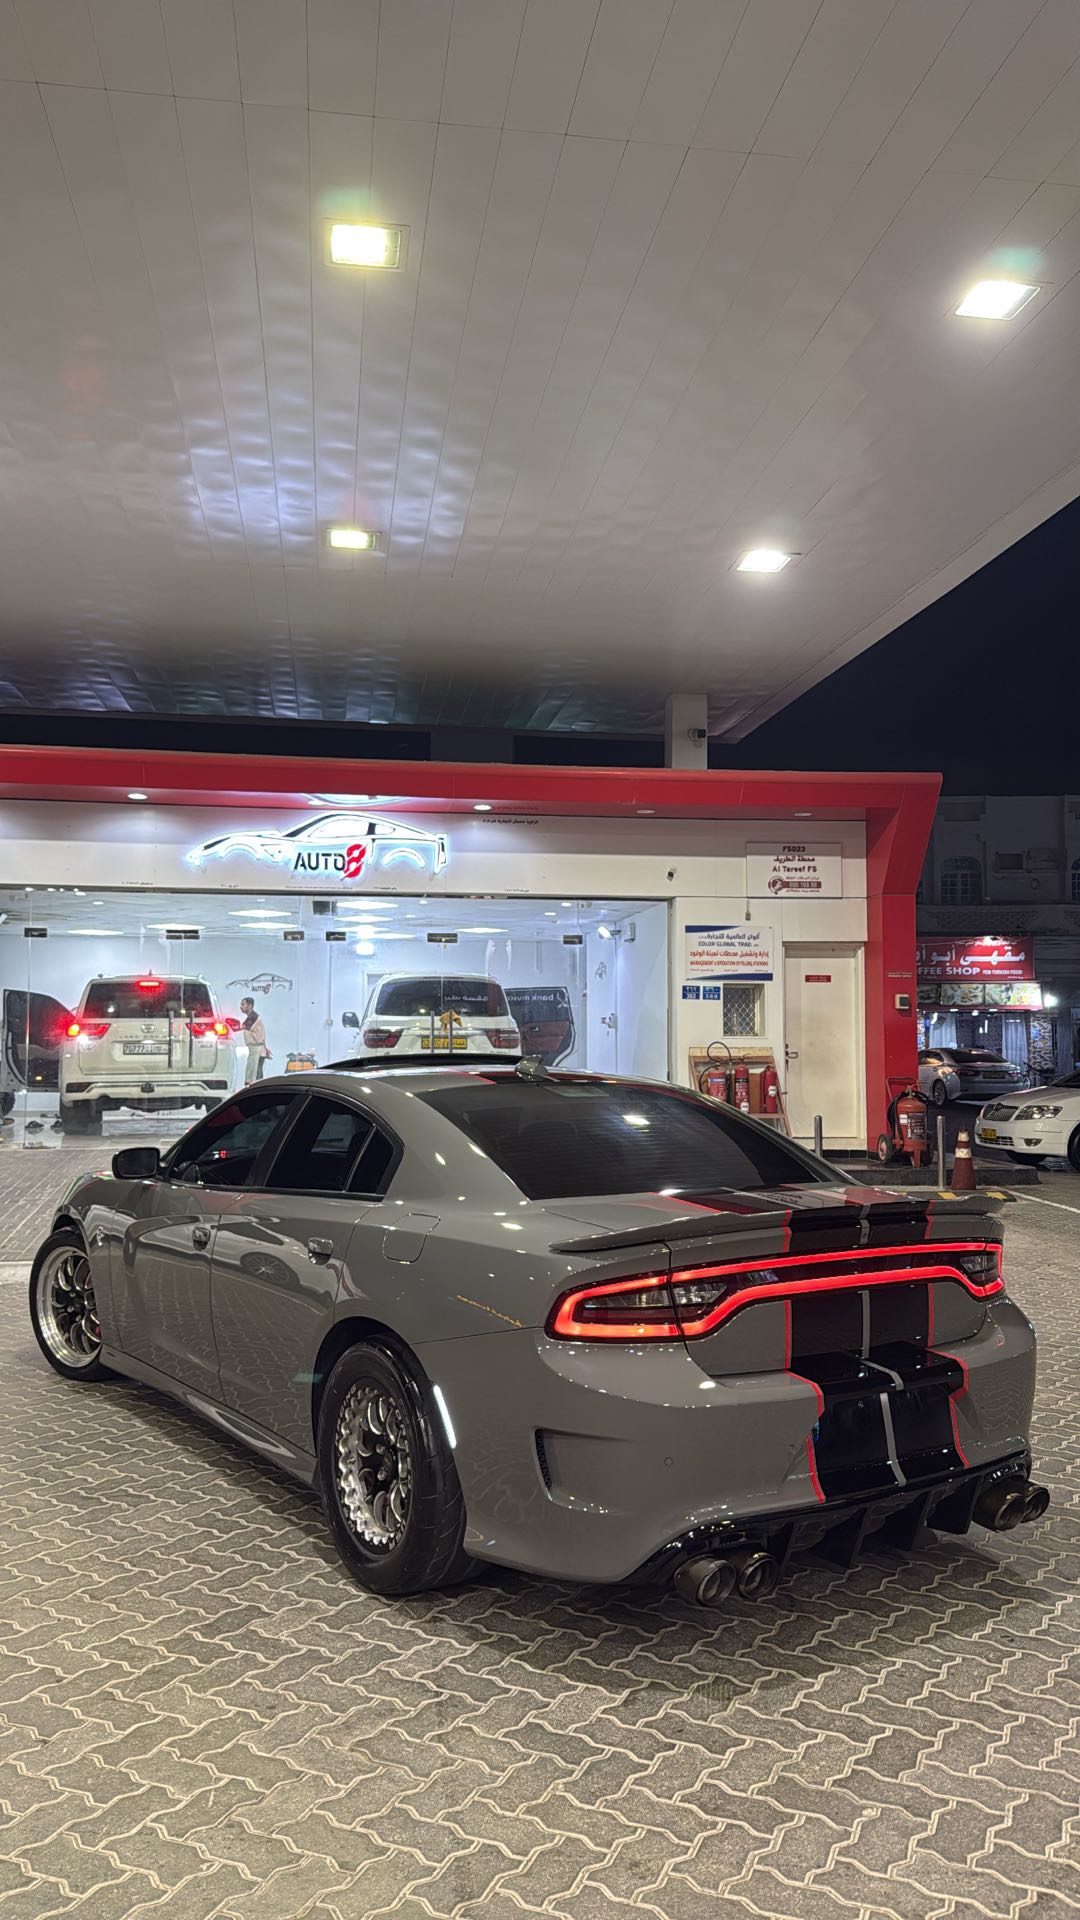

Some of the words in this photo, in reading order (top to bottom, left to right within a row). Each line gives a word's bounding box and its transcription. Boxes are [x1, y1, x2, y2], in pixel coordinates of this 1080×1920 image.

[797, 855, 816, 863] محطة
[930, 944, 956, 967] أبو
[960, 946, 1026, 966] مقهى
[917, 966, 944, 976] FFEE
[945, 966, 980, 976] SHOP
